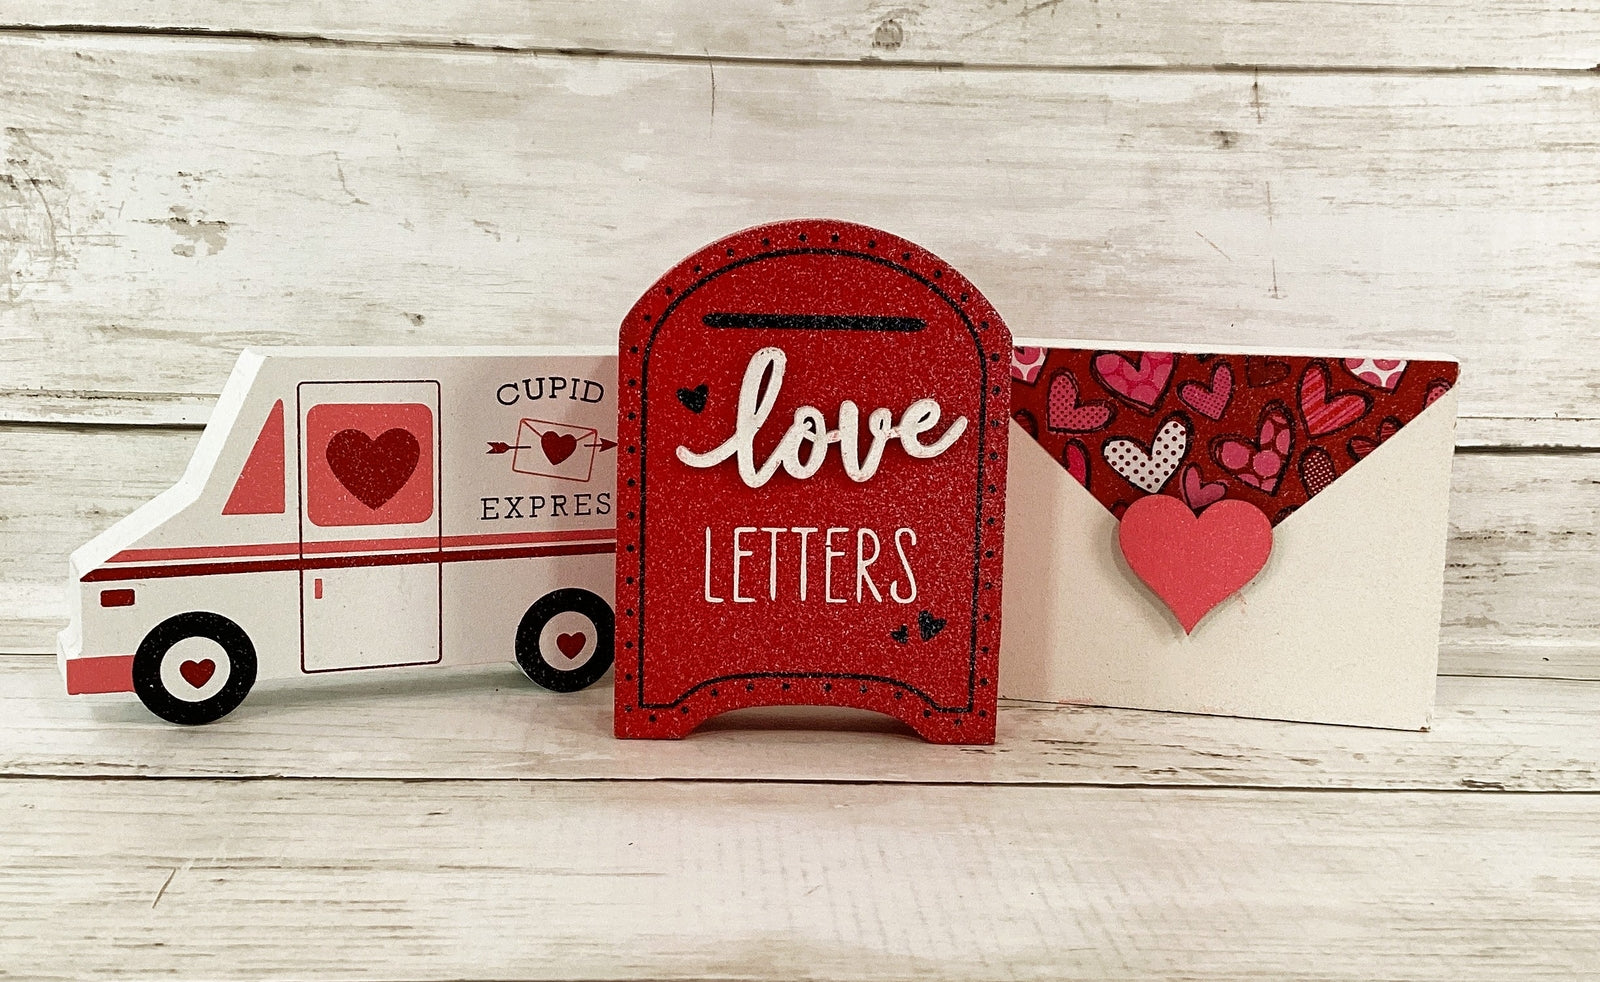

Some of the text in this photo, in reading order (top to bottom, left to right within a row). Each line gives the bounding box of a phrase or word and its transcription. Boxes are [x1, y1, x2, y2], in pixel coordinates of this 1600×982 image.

[496, 376, 605, 406] CUPID
[675, 346, 968, 488] love
[480, 492, 611, 521] EXPRES
[704, 526, 918, 604] LETTERS
